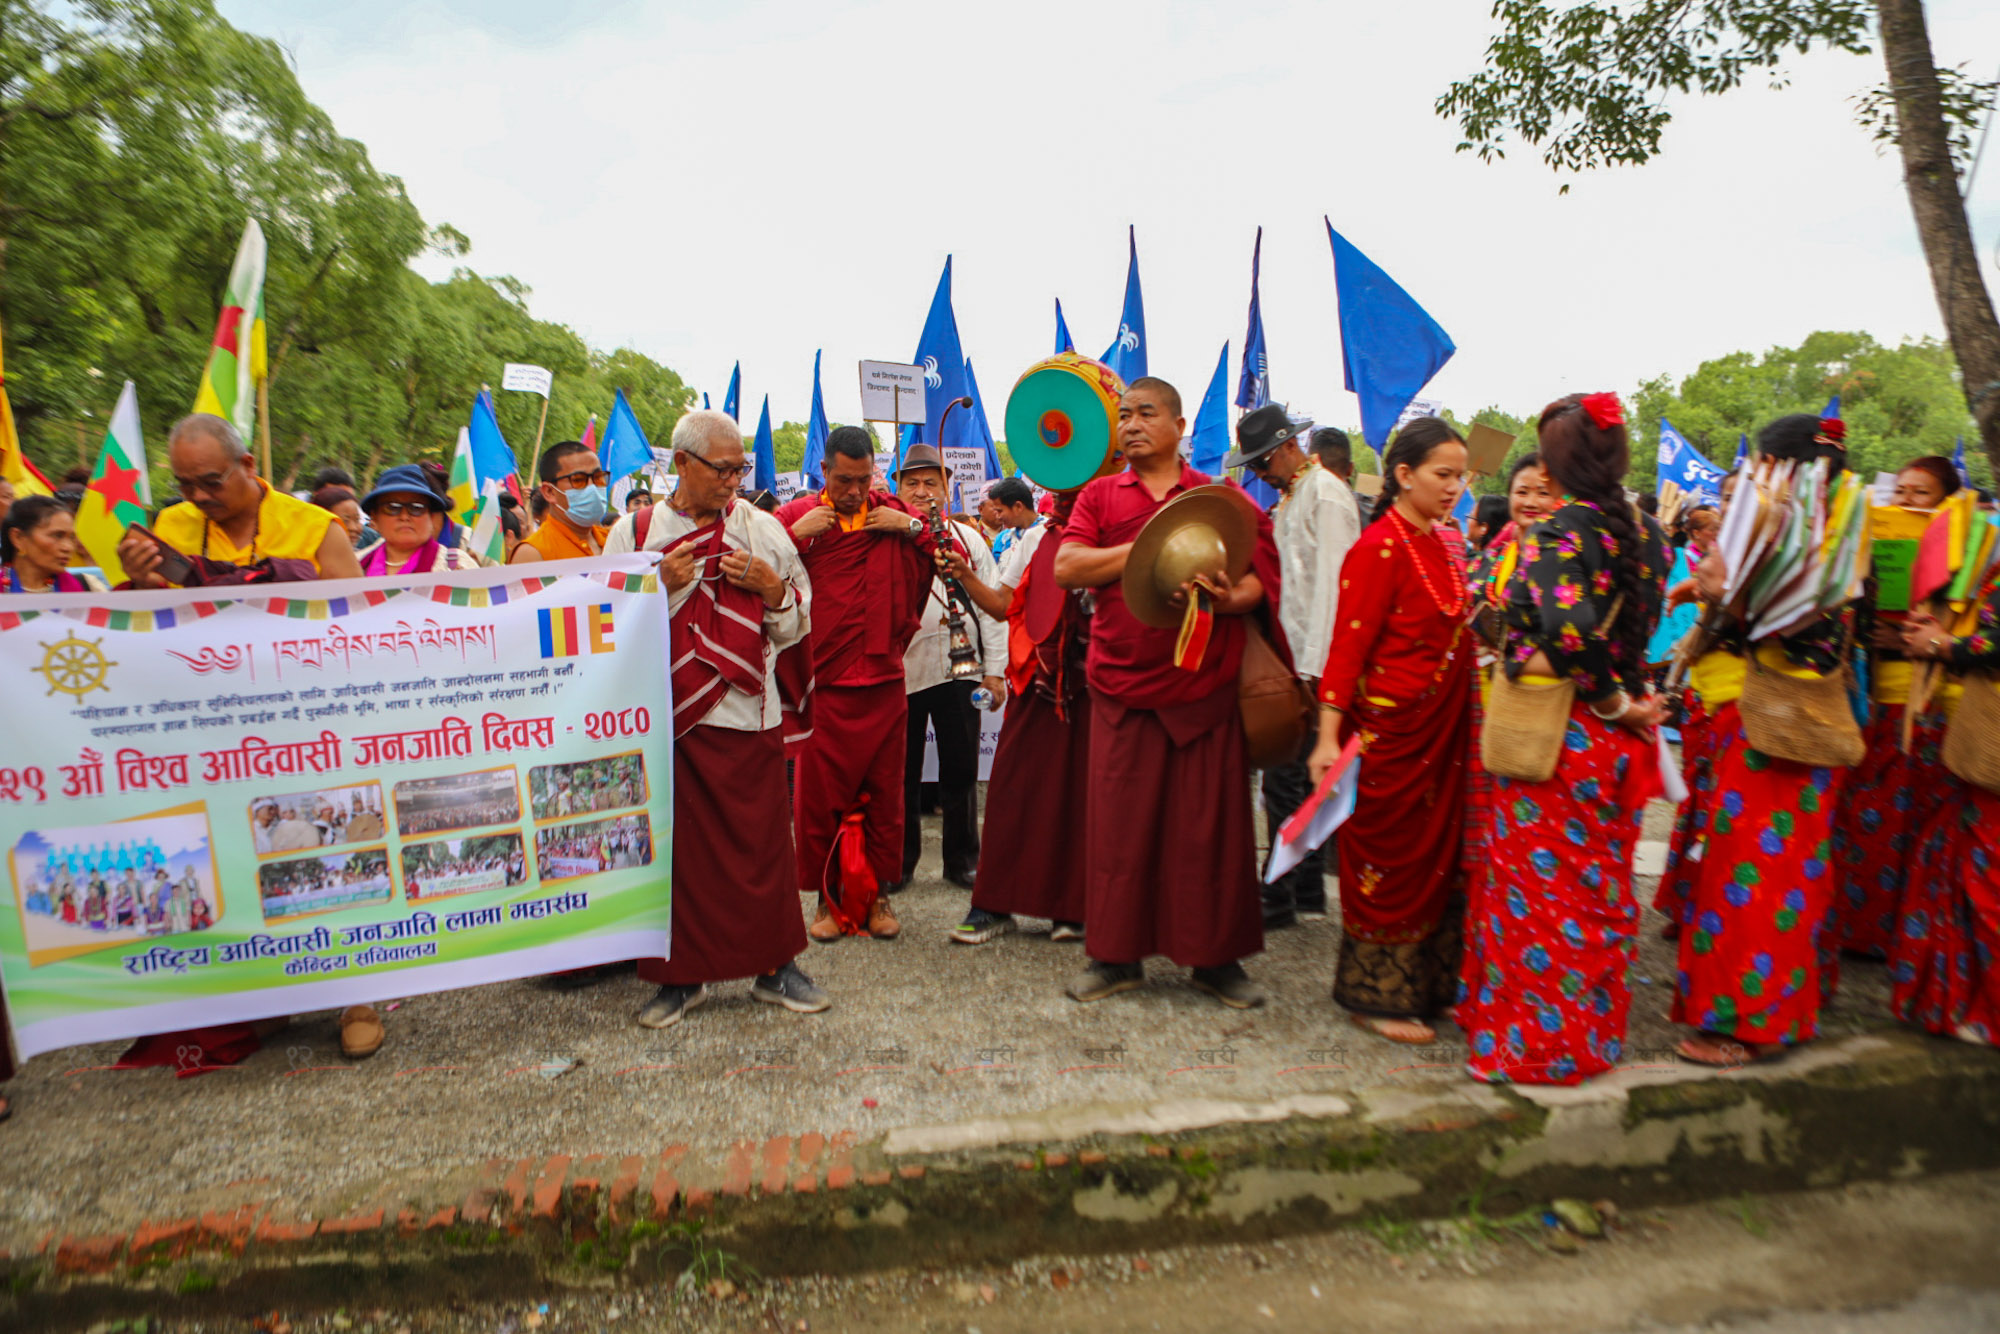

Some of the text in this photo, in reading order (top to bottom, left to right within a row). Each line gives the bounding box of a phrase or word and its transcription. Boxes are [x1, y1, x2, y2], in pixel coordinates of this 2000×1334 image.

[960, 462, 982, 471] कोशी
[332, 681, 385, 698] आदिवासी
[390, 677, 436, 692] जनजाति
[442, 673, 504, 688] आन्दोलनमा
[509, 666, 549, 682] सहभागी
[385, 699, 410, 710] भाषा
[416, 697, 423, 709] र
[428, 690, 484, 708] संस्कृतिको
[489, 687, 526, 701] संरक्षण
[0, 765, 46, 801] २९
[116, 748, 190, 791] विश्व
[200, 730, 343, 783] आदिवासी
[352, 716, 472, 767] जनजाति
[482, 712, 554, 752] दिवस
[584, 706, 651, 741] २०८०
[122, 891, 588, 975] राष्ट्रिय आदिवासी जनजाति लामा महासंघ
[284, 942, 437, 977] केन्द्रिय सचिवालय
